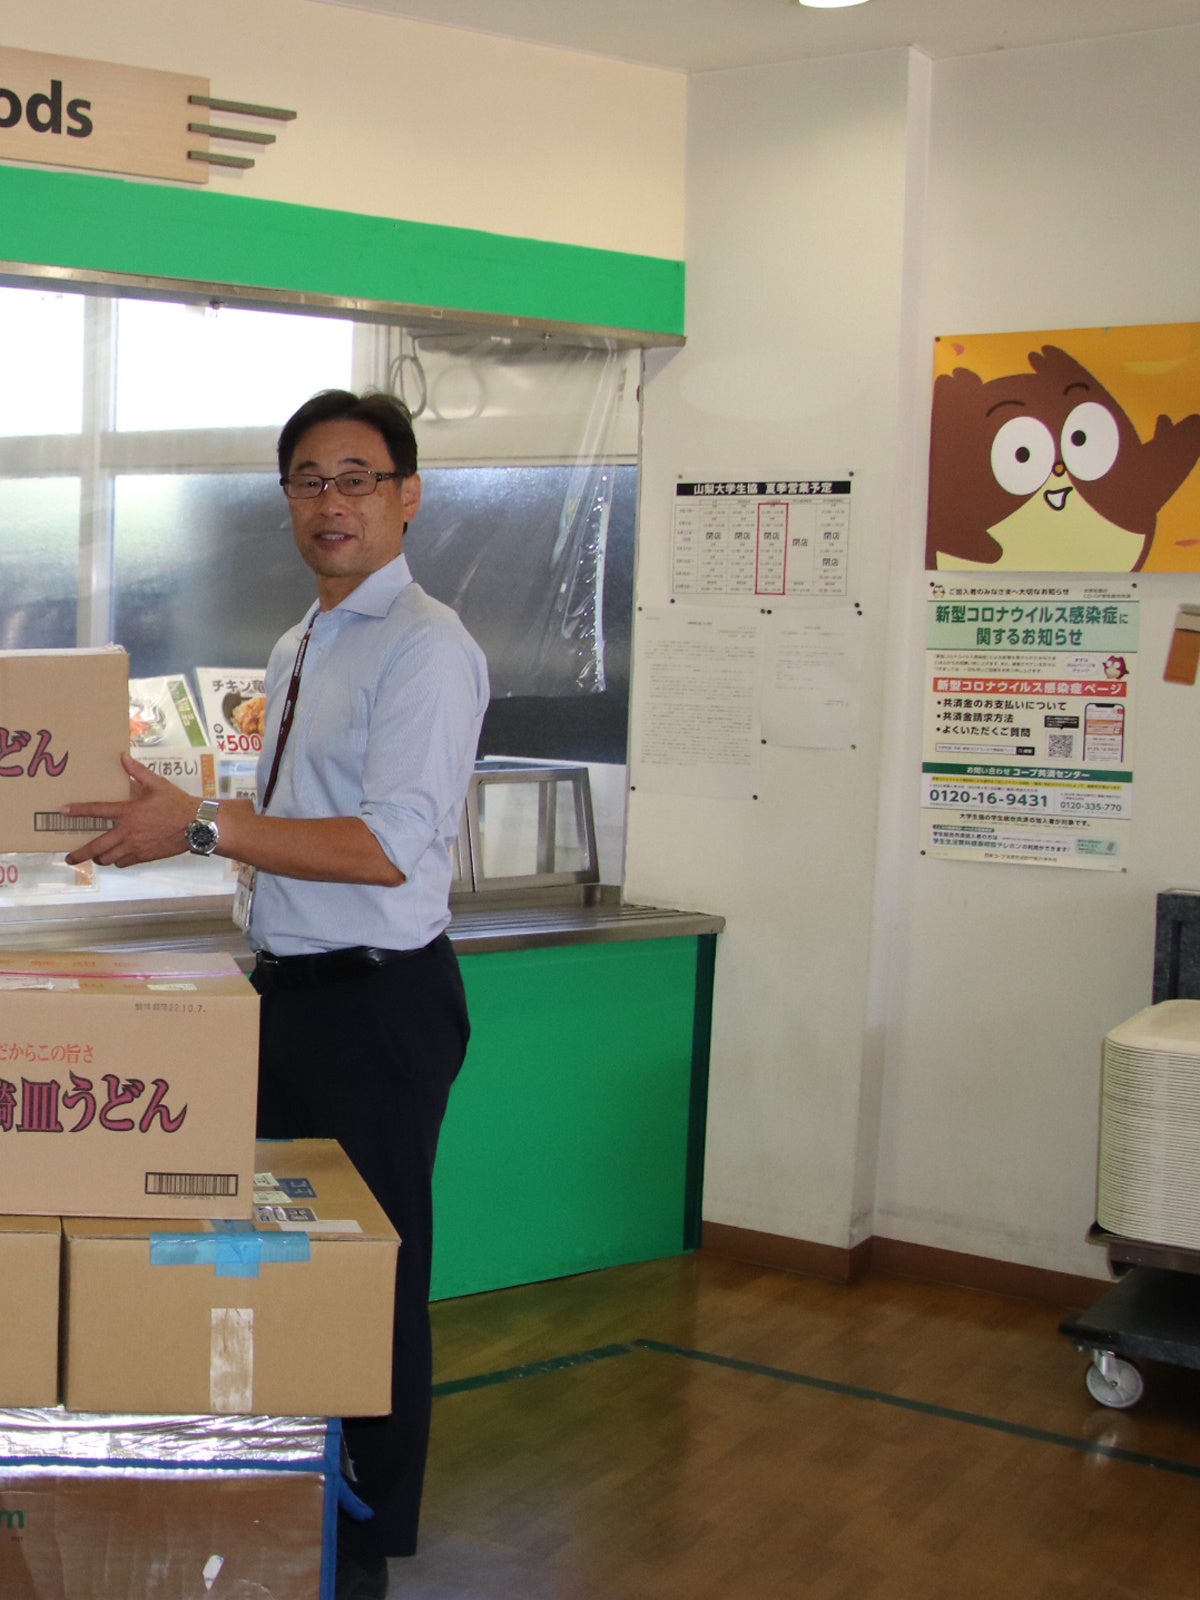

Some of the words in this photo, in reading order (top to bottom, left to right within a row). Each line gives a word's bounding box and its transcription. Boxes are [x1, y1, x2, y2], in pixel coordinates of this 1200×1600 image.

[935, 605, 1129, 625] 新型コロナウイルス感染症に
[976, 627, 1083, 646] 関するお知らせ
[936, 678, 1123, 696] 新型コロナウイルス感染症ページ
[943, 698, 1068, 711] 共済金のお支払いについて
[942, 711, 1014, 723] 共済金請求方法
[942, 725, 1031, 738] よくいただくご質問
[217, 734, 263, 752] ¥500
[1012, 768, 1090, 779] コープ共済センター
[929, 789, 1049, 807] 0120-16-9431
[1060, 801, 1122, 812] 0120-335-770
